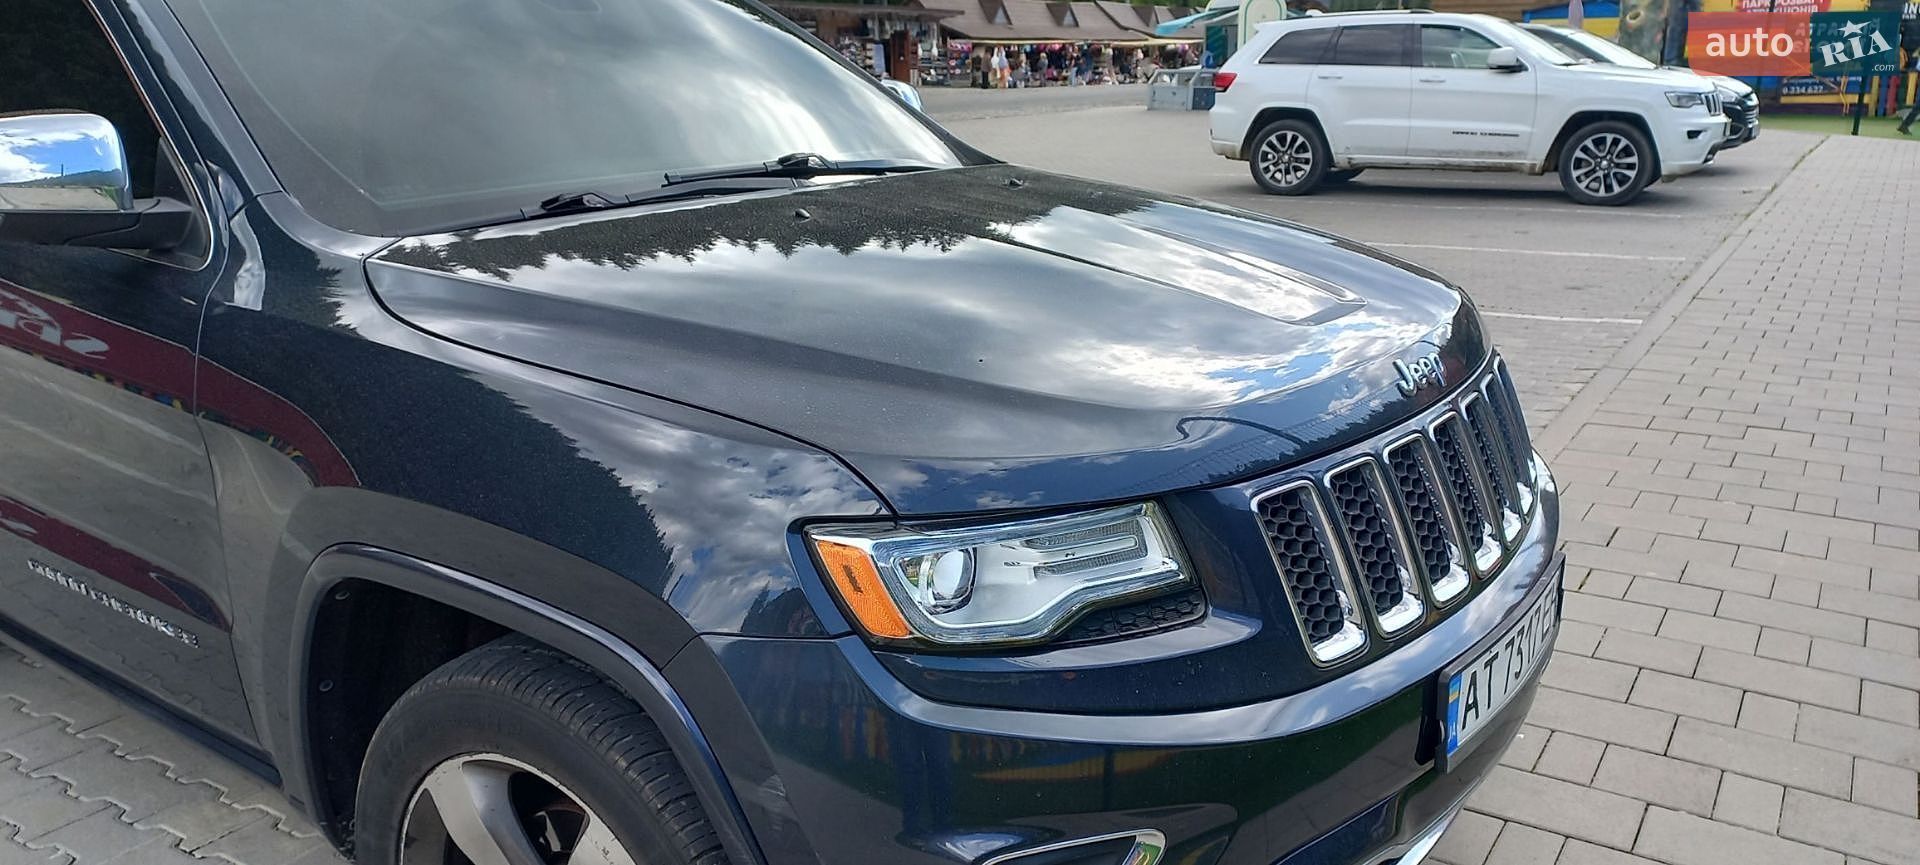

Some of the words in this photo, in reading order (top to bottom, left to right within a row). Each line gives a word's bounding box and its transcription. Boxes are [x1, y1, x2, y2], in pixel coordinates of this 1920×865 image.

[1393, 352, 1448, 396] Jeep
[1462, 650, 1499, 731] AT
[1504, 604, 1541, 695] 7317
